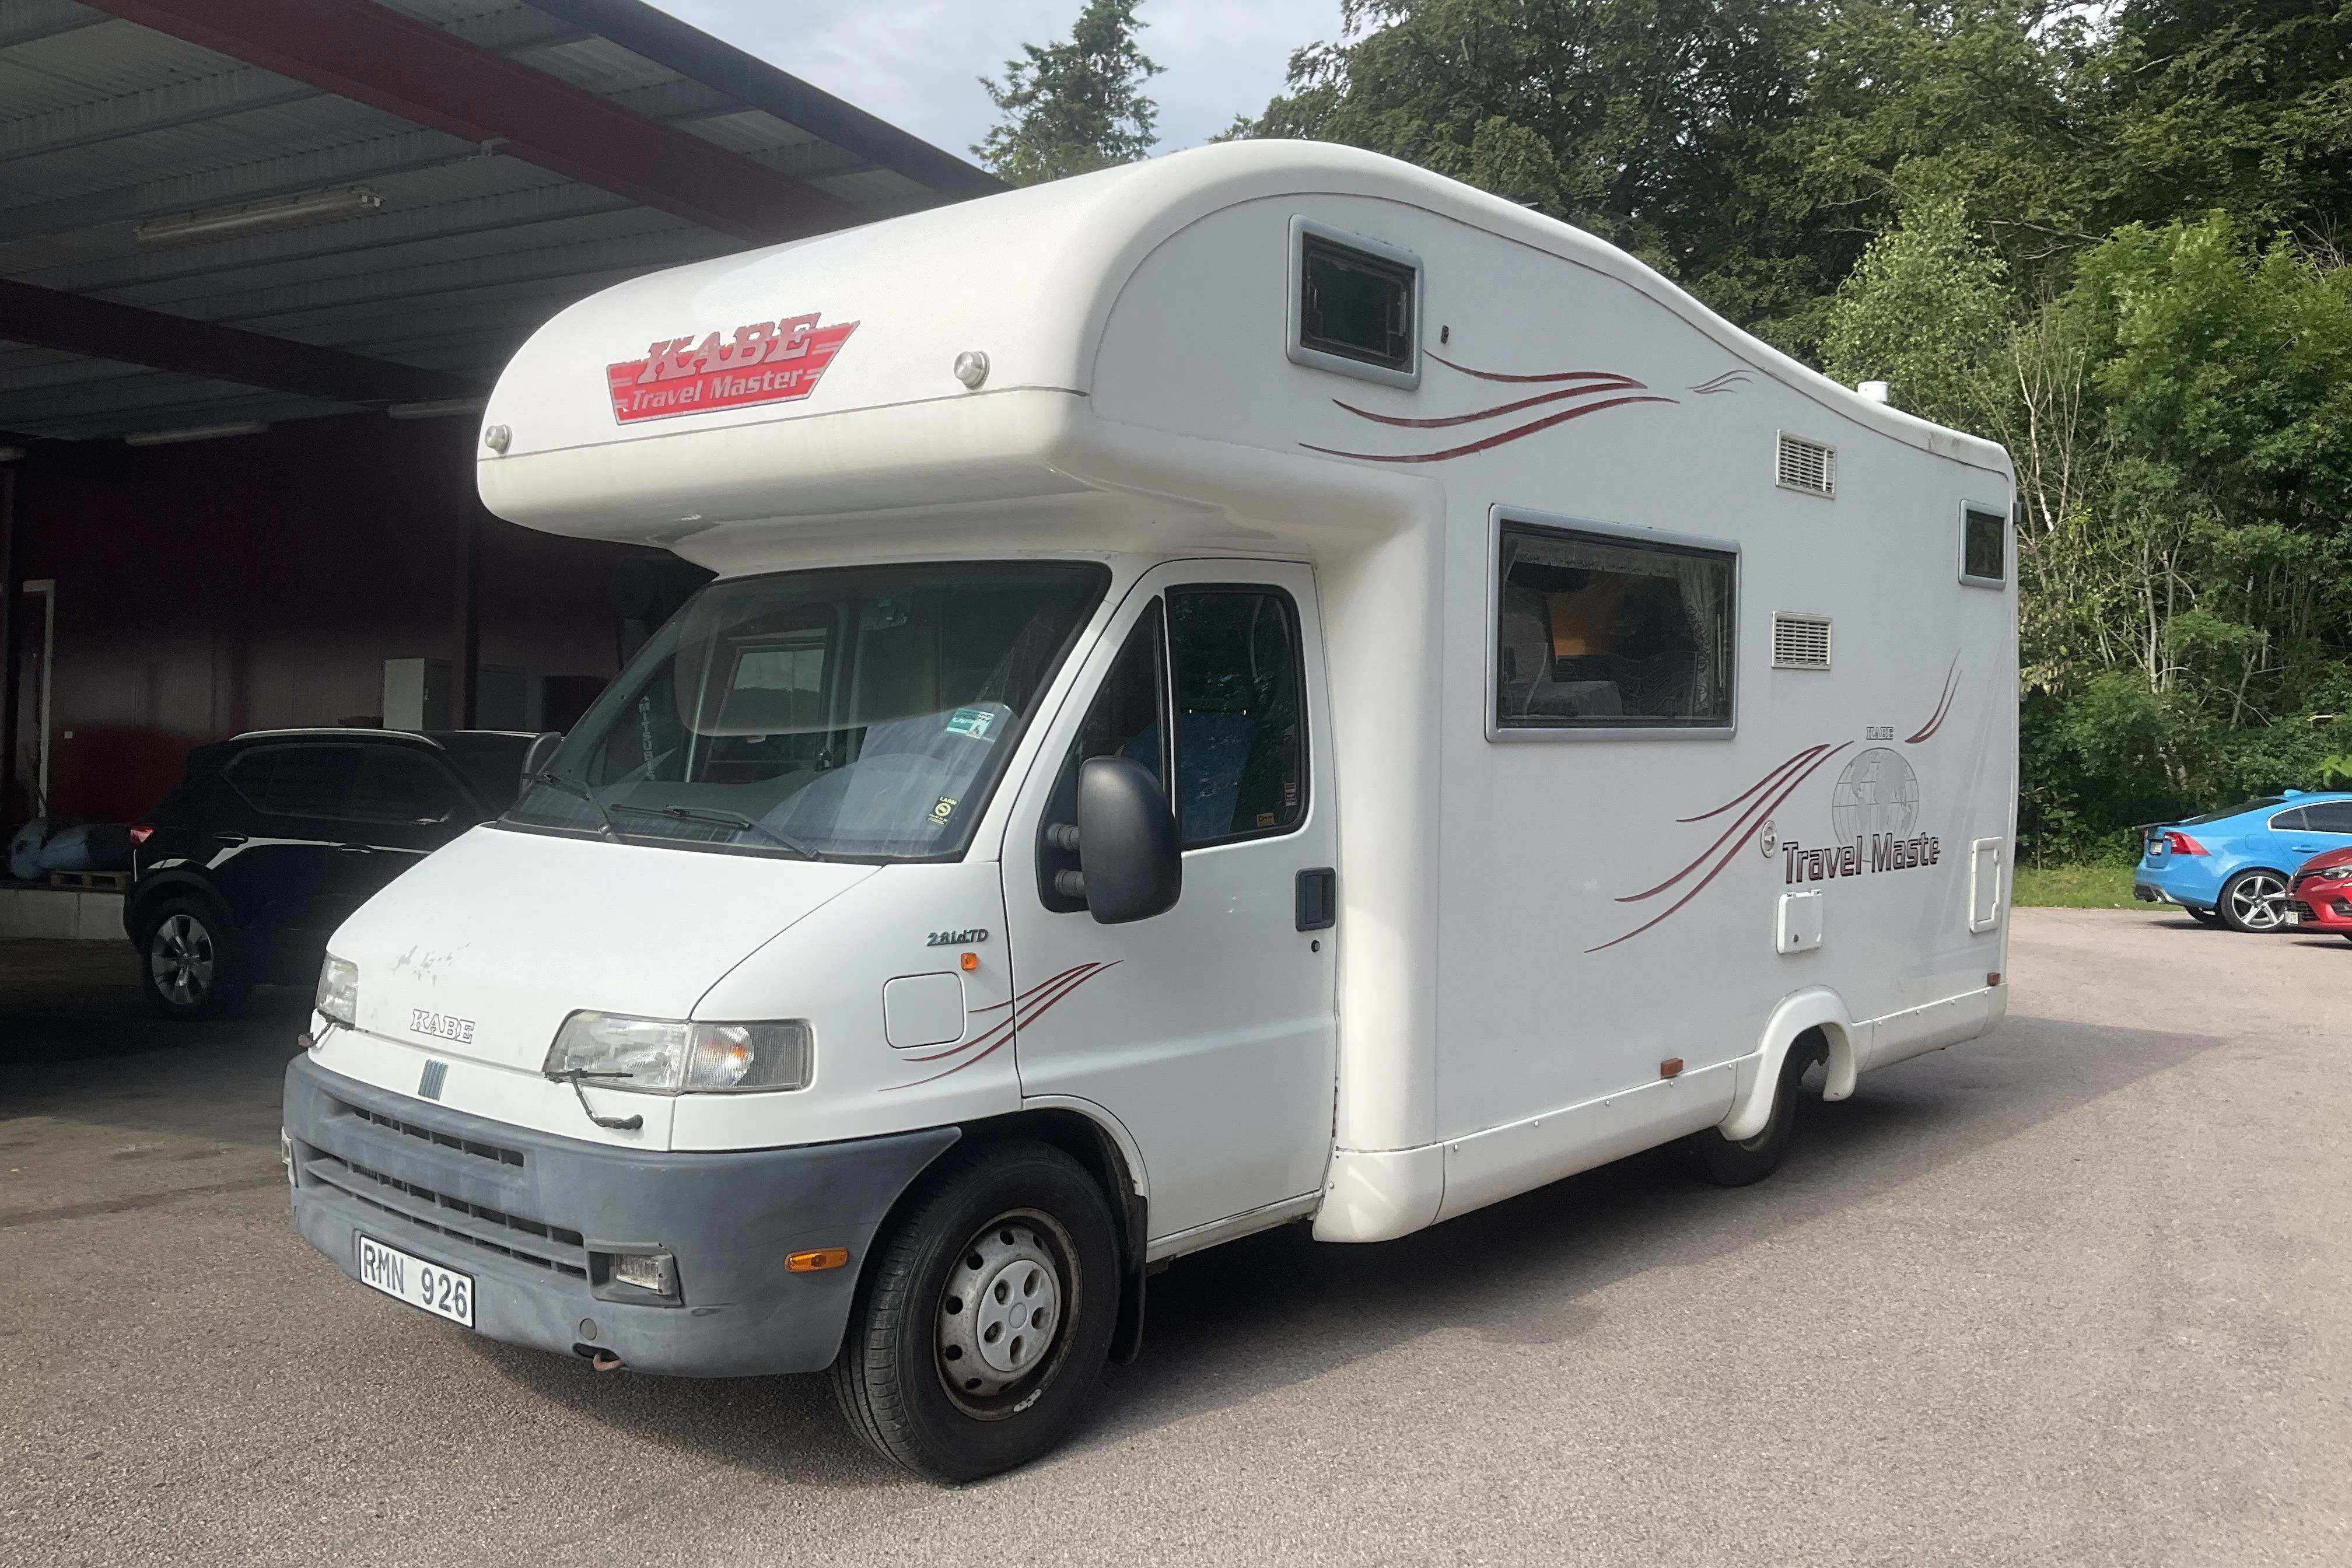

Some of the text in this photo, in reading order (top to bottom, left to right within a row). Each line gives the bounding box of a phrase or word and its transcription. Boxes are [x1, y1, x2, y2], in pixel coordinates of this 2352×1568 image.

[635, 312, 821, 385] KABE
[631, 368, 804, 411] Travel Master
[1866, 726, 1894, 740] KABE
[939, 796, 957, 806] LARM
[1783, 832, 1940, 884] Travel Maste
[410, 1009, 475, 1044] KABE
[364, 1243, 467, 1318] RMN 926
